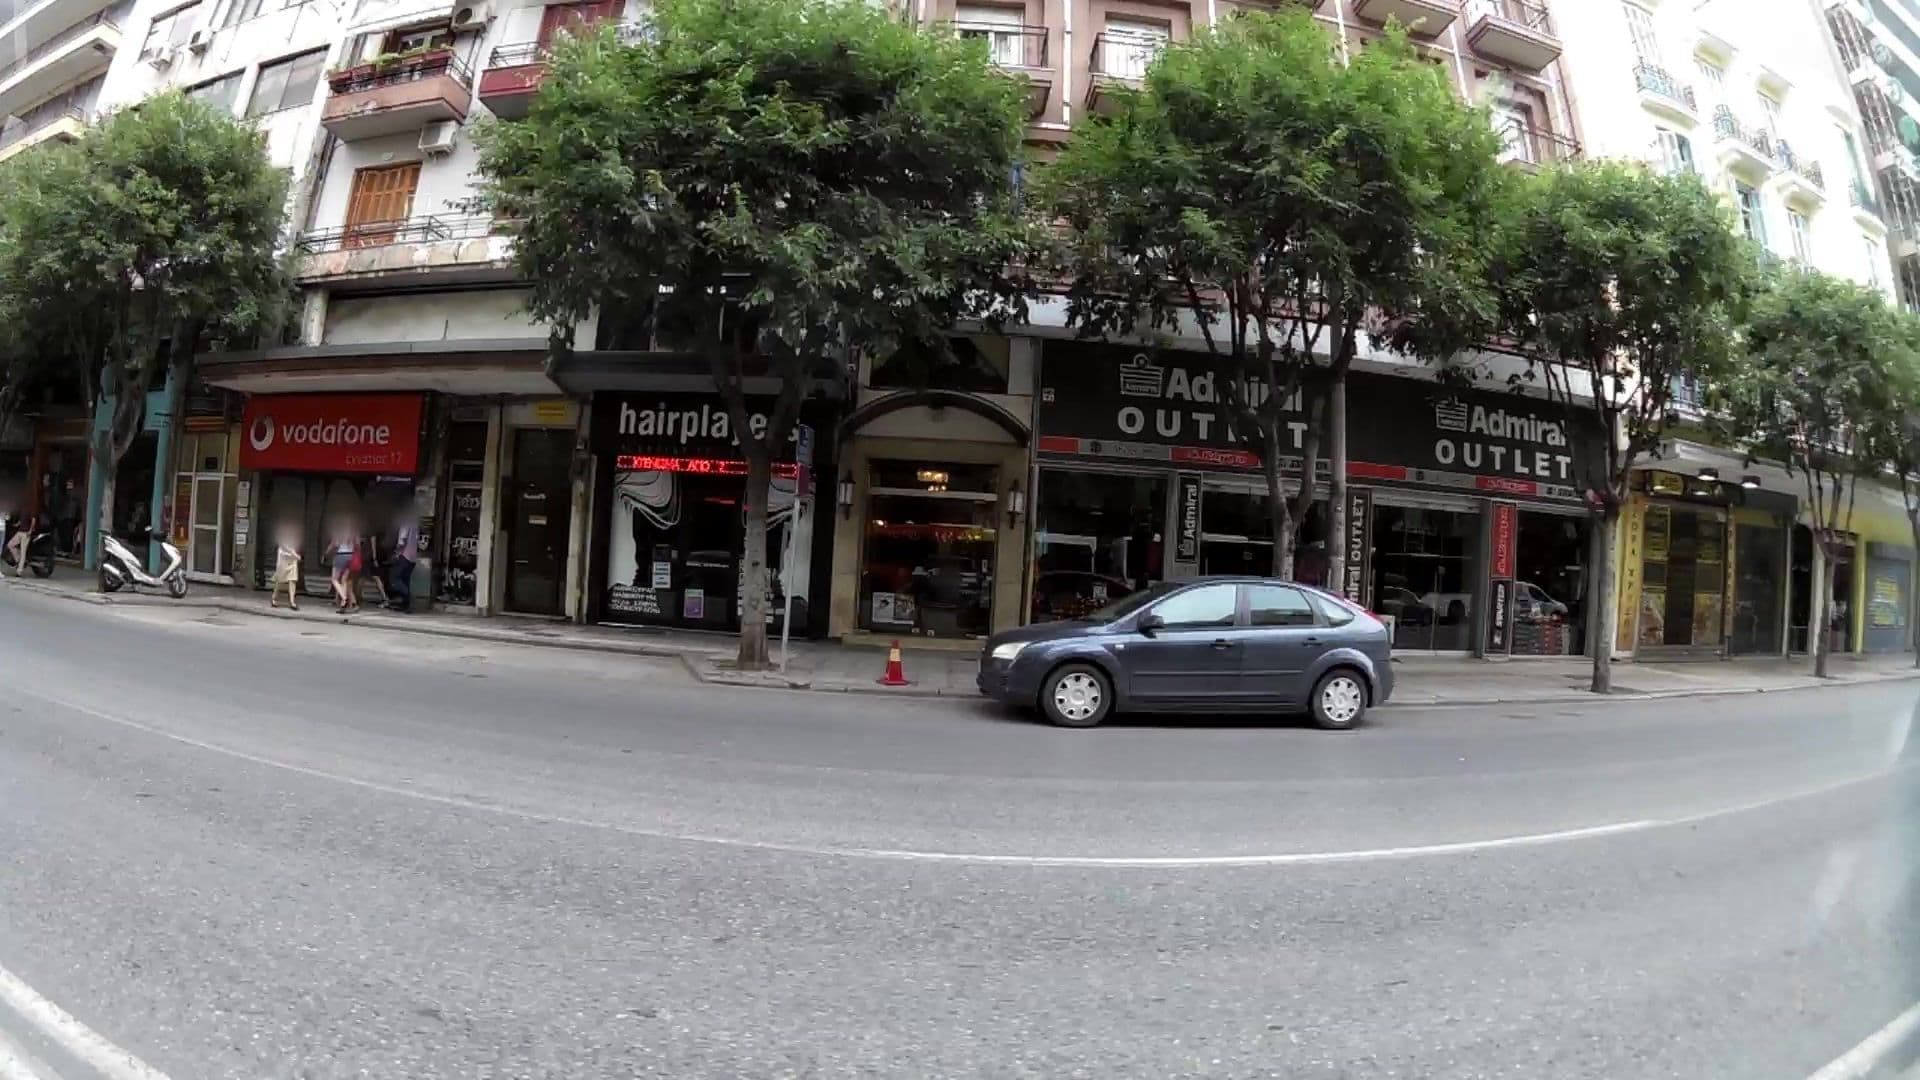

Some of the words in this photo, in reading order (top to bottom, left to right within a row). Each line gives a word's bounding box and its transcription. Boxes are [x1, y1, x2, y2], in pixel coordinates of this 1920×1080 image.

[282, 417, 390, 445] vodafone
[1117, 406, 1308, 449] OUTT
[1469, 405, 1566, 447] Admiral
[1435, 438, 1571, 479] OUTLET
[1183, 484, 1197, 539] Admiral
[1351, 496, 1363, 561] OUTLET
